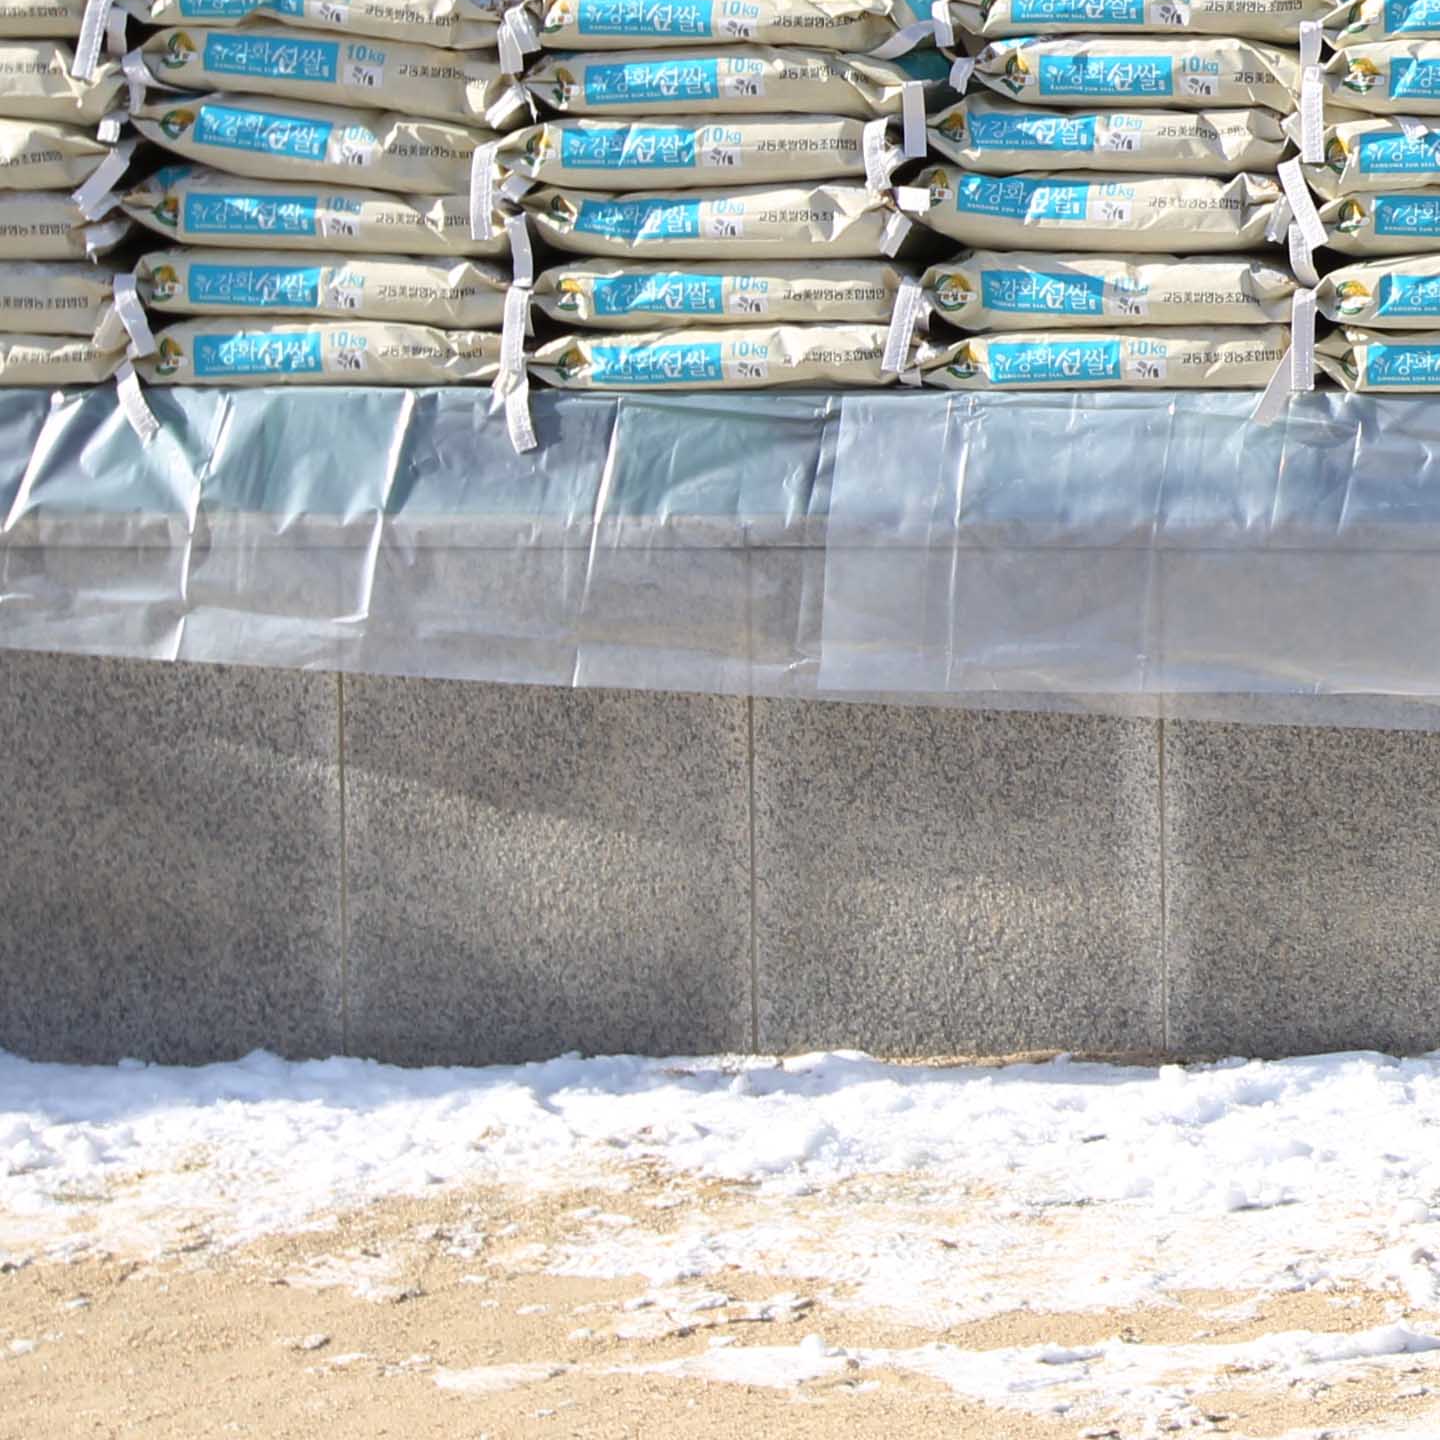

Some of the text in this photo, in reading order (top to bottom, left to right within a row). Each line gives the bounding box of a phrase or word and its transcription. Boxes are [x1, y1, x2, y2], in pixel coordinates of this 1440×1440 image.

[721, 0, 760, 18] 10kg
[346, 43, 386, 63] 10kg
[726, 57, 765, 75] 10kg
[1179, 56, 1219, 74] 10kg
[1104, 115, 1143, 129] 10kg
[704, 127, 742, 145] 10kg
[1097, 182, 1136, 199] 10kg
[325, 196, 361, 213] 10kg
[708, 200, 745, 215] 10kg
[730, 276, 768, 293] 10kg
[328, 331, 367, 350] 10kg
[1128, 340, 1167, 358] 10kg
[730, 341, 768, 359] 10kg
